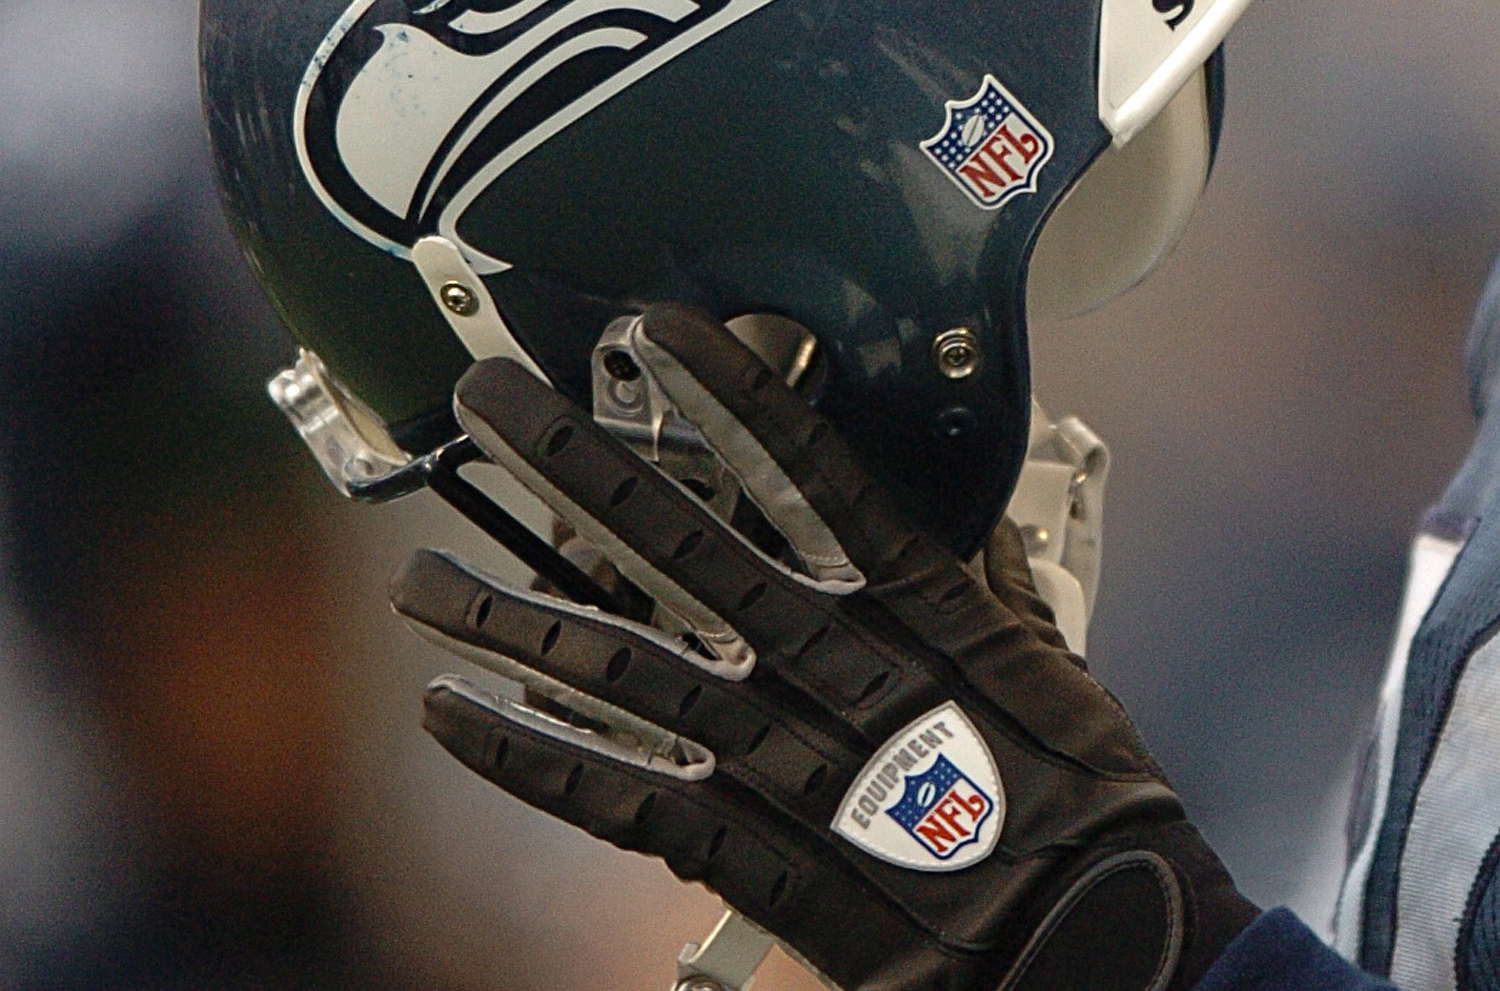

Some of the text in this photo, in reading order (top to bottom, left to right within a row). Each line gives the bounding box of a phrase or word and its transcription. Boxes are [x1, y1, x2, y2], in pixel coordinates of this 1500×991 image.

[960, 124, 1038, 198] NFL
[851, 721, 954, 829] EQUIPMENT
[916, 791, 986, 853] NFL
